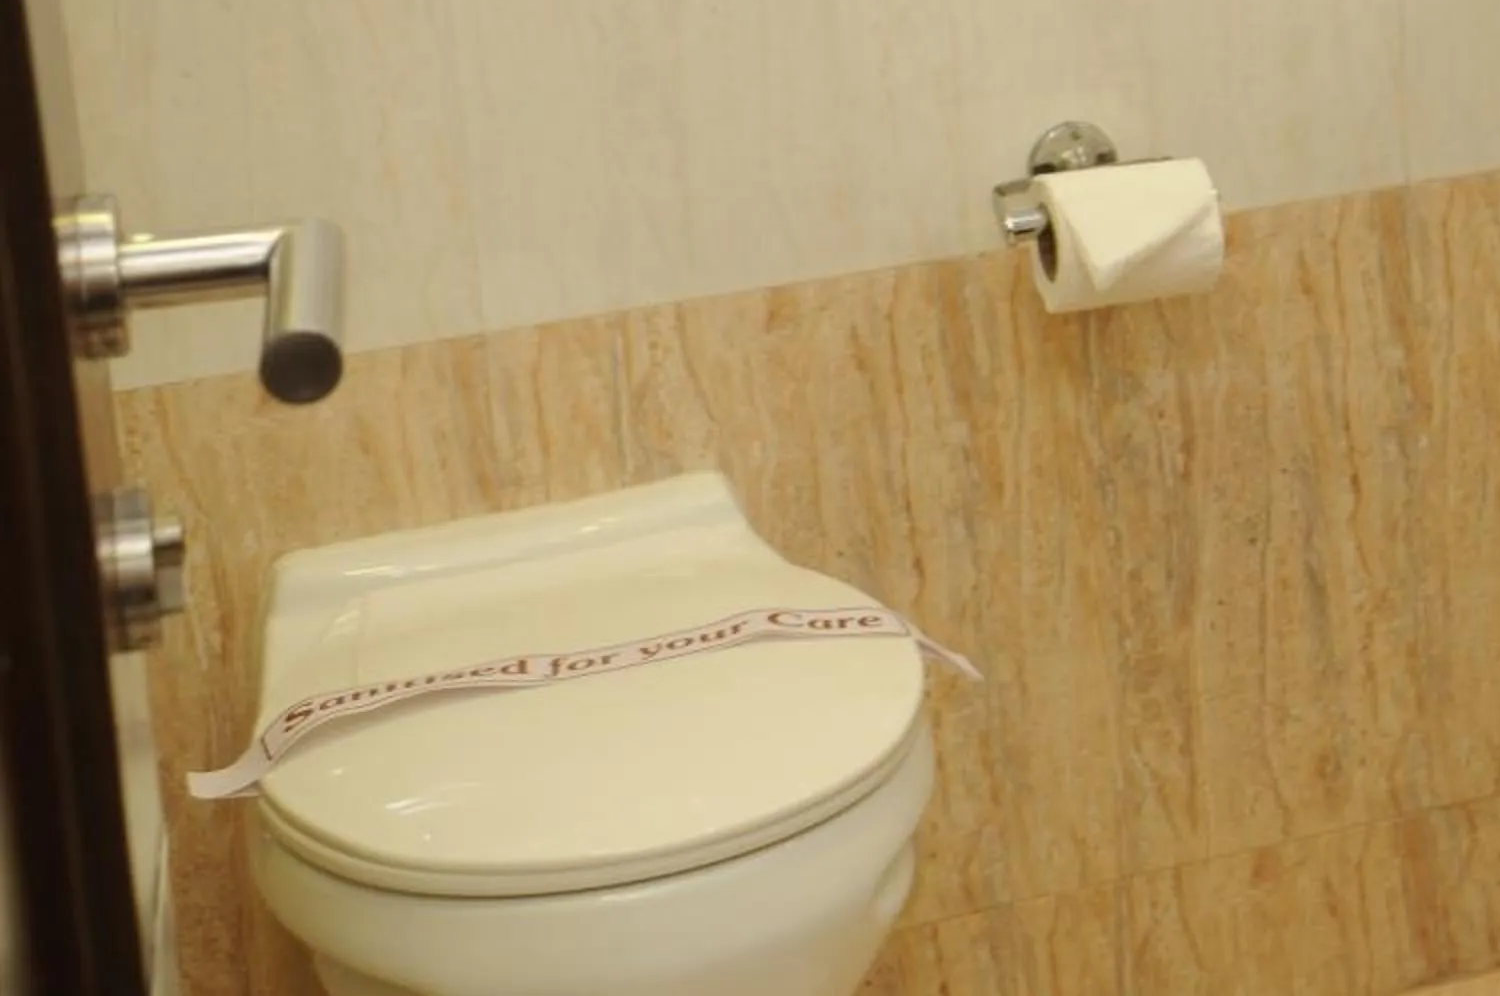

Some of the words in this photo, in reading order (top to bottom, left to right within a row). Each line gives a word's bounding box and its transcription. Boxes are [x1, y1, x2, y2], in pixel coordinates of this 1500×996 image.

[545, 653, 621, 679] for
[639, 619, 748, 660] your
[766, 610, 883, 630] Care
